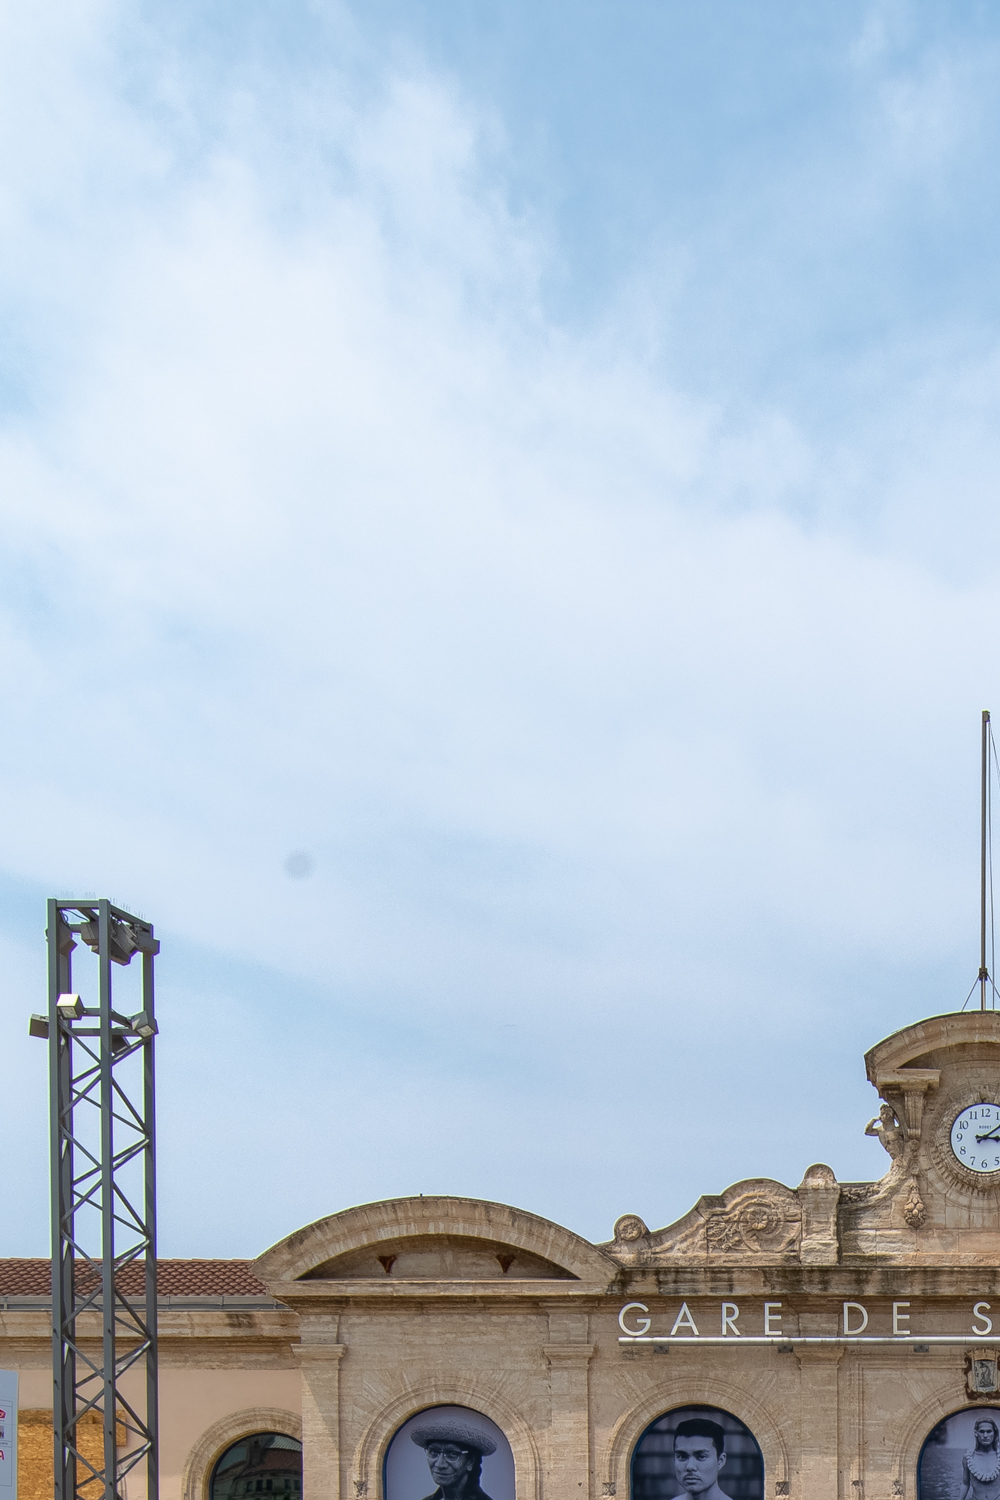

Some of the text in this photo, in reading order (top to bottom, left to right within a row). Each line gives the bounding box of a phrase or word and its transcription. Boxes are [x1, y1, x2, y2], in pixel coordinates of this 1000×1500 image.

[969, 1111, 978, 1120] 11
[981, 1108, 991, 1118] 12
[996, 1111, 1000, 1120] 1
[959, 1120, 969, 1130] 10
[956, 1133, 963, 1142] 9
[960, 1146, 966, 1155] 8
[970, 1156, 976, 1166] 7
[981, 1158, 988, 1168] 6
[994, 1156, 1000, 1166] 5
[618, 1302, 783, 1337] GARE
[843, 1301, 911, 1336] DE
